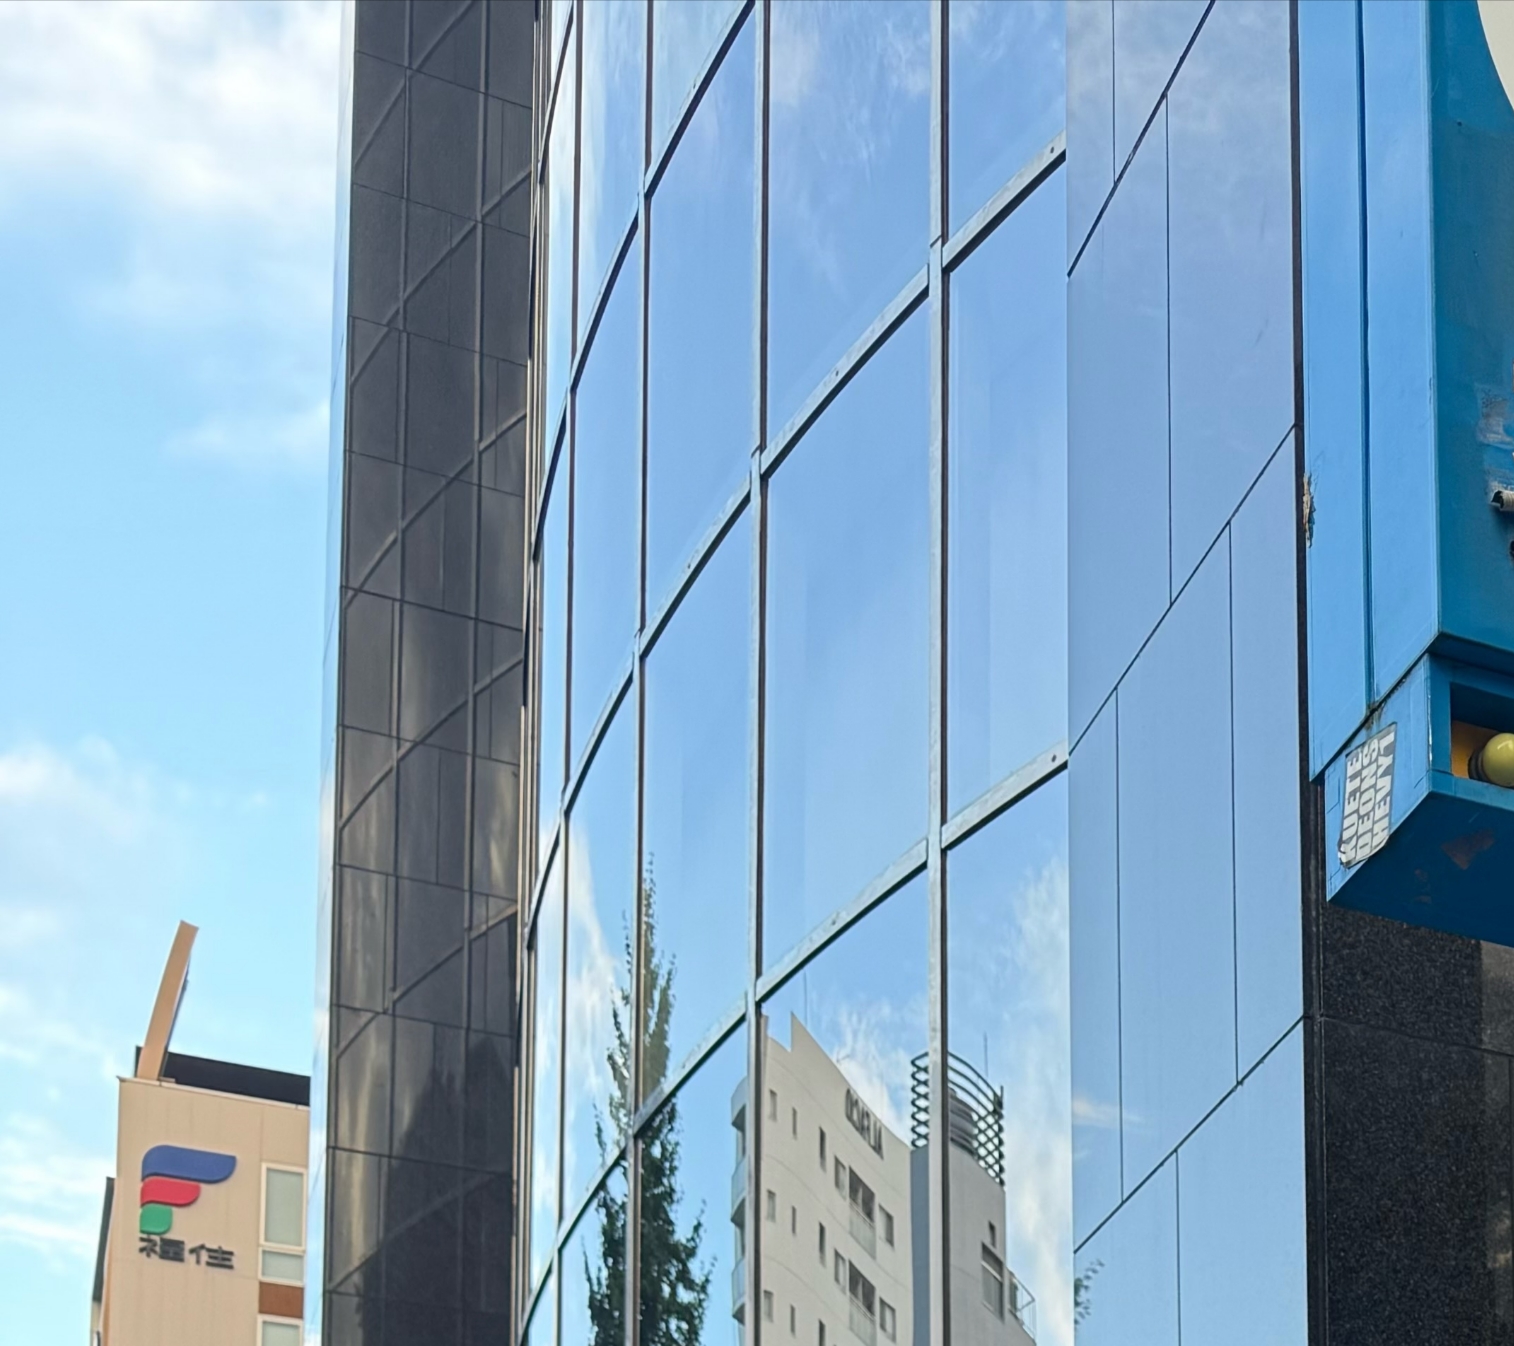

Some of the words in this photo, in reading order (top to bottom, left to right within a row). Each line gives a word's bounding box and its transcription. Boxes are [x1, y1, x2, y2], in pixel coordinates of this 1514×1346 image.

[1340, 753, 1362, 862] KUETE
[1356, 739, 1378, 857] DEONS
[138, 1234, 235, 1270] 福住
